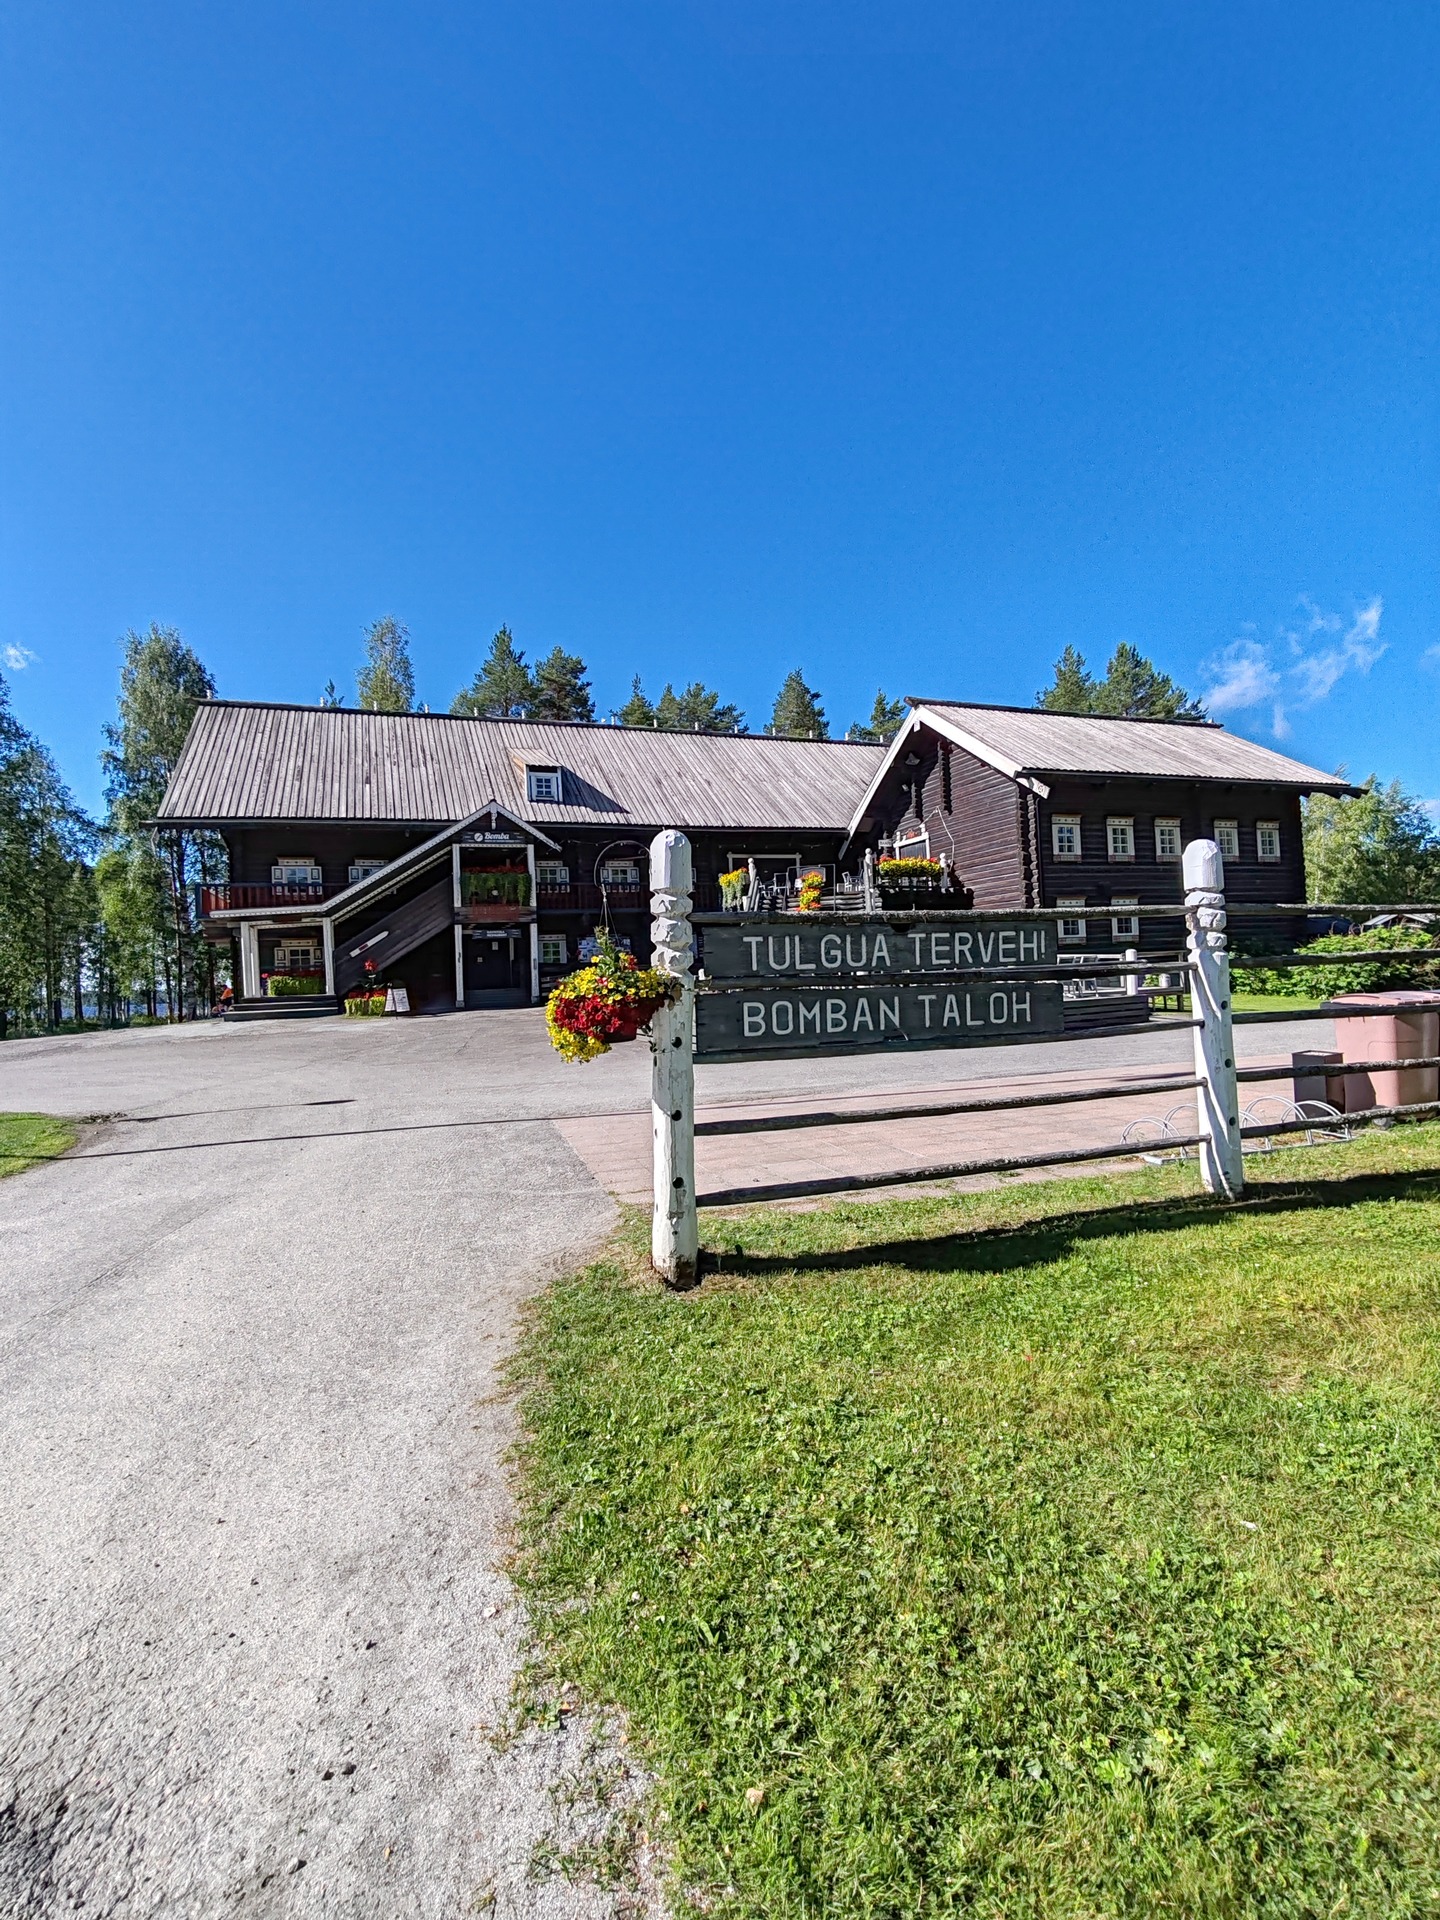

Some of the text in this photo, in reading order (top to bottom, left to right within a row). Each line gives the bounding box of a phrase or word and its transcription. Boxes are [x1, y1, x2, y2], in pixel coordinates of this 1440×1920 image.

[484, 831, 510, 840] Bomba
[742, 930, 1046, 972] TULGUA TERVEH!
[742, 991, 1031, 1037] BOMBAN TALOH
